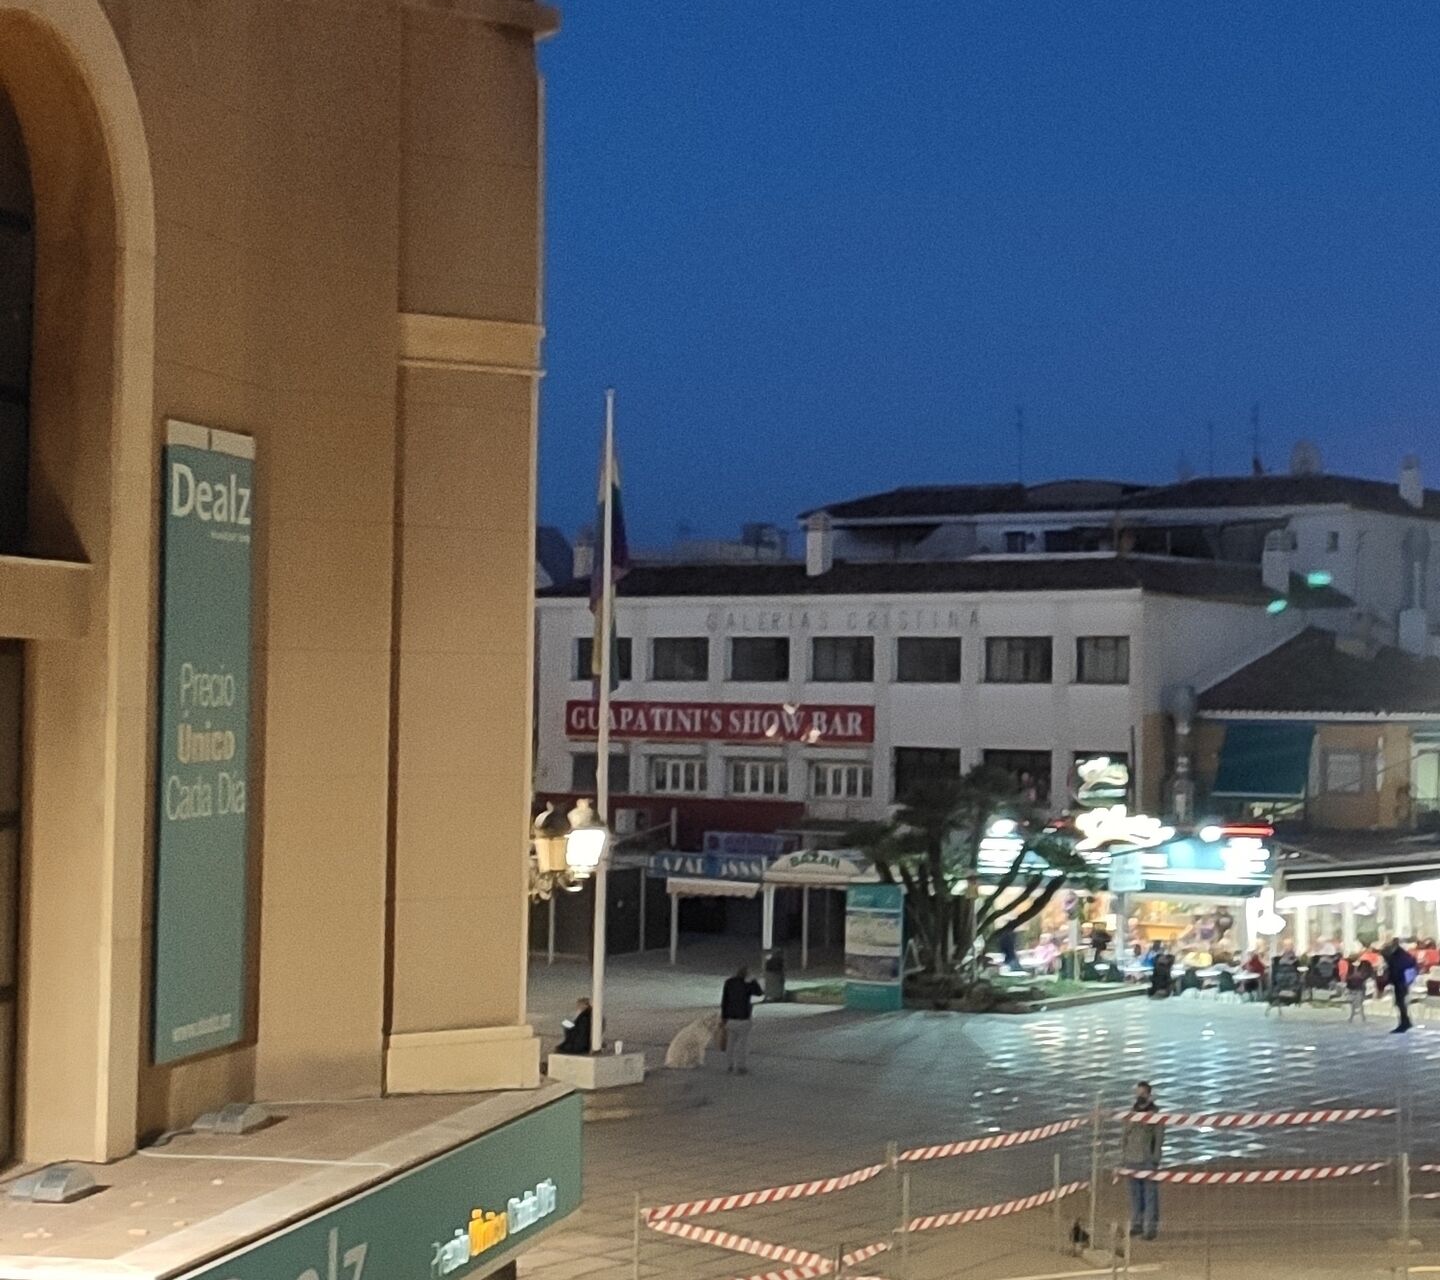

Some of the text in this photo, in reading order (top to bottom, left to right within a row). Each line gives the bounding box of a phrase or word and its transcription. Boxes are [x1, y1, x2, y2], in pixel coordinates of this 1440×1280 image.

[172, 463, 252, 525] Dealz
[728, 709, 806, 736] SHOW
[811, 710, 863, 737] BAR
